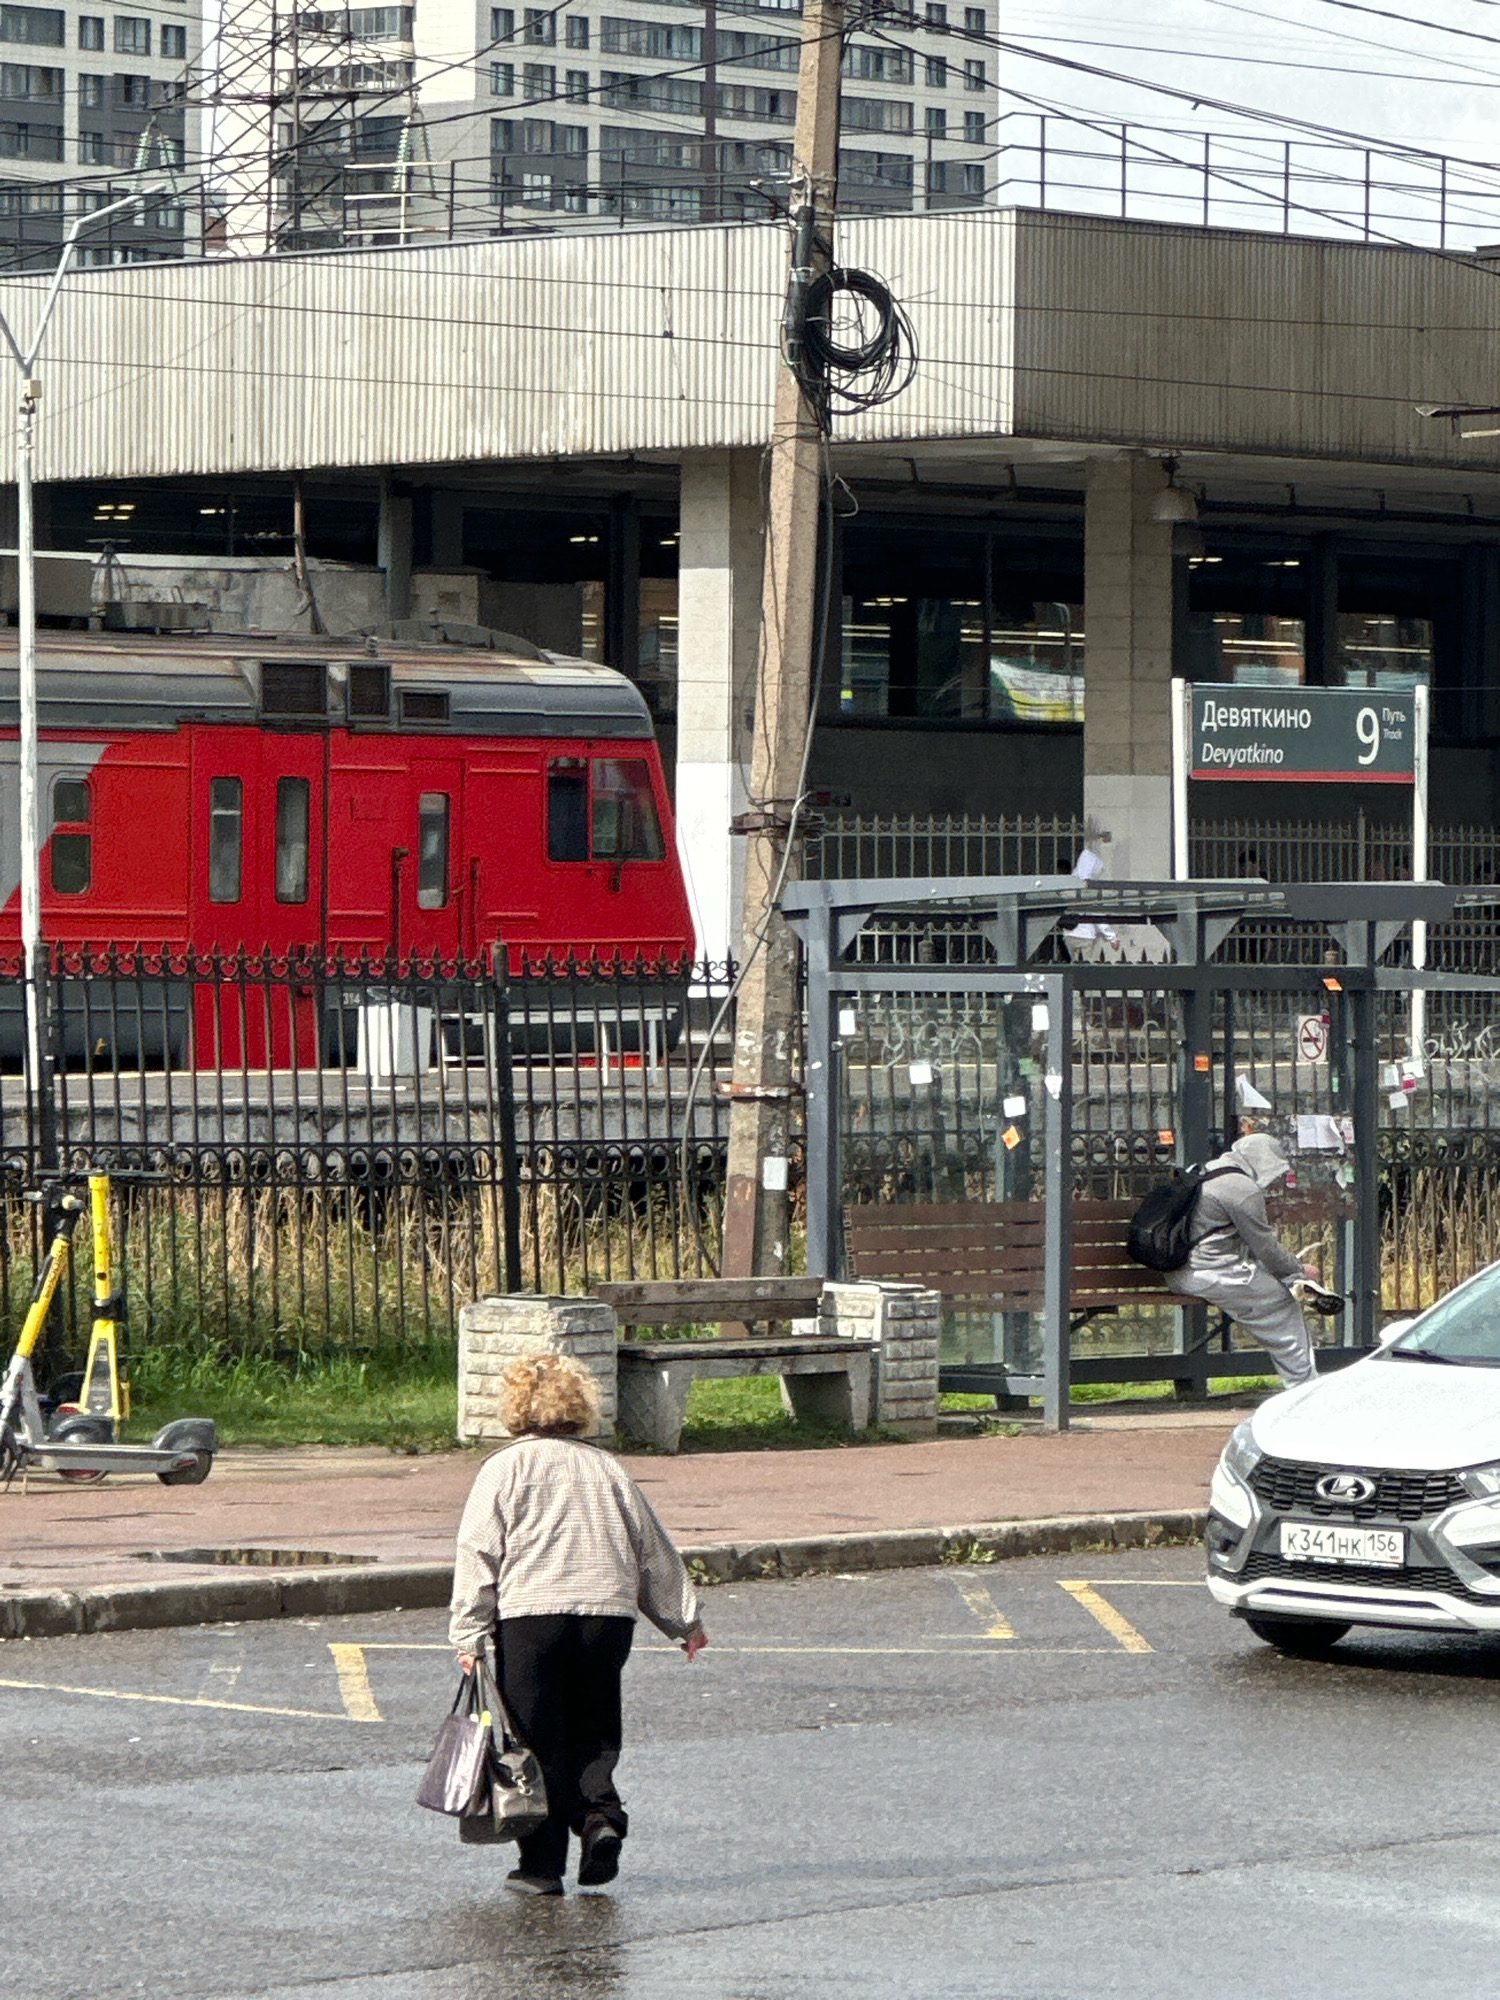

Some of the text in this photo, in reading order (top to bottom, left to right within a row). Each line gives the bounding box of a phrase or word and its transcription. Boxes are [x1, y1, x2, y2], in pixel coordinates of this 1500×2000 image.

[1201, 700, 1312, 732] Девяткино
[1382, 707, 1407, 726] Путь
[1356, 707, 1380, 765] 9
[1202, 743, 1284, 768] Devyatkino
[1367, 1533, 1397, 1552] 156
